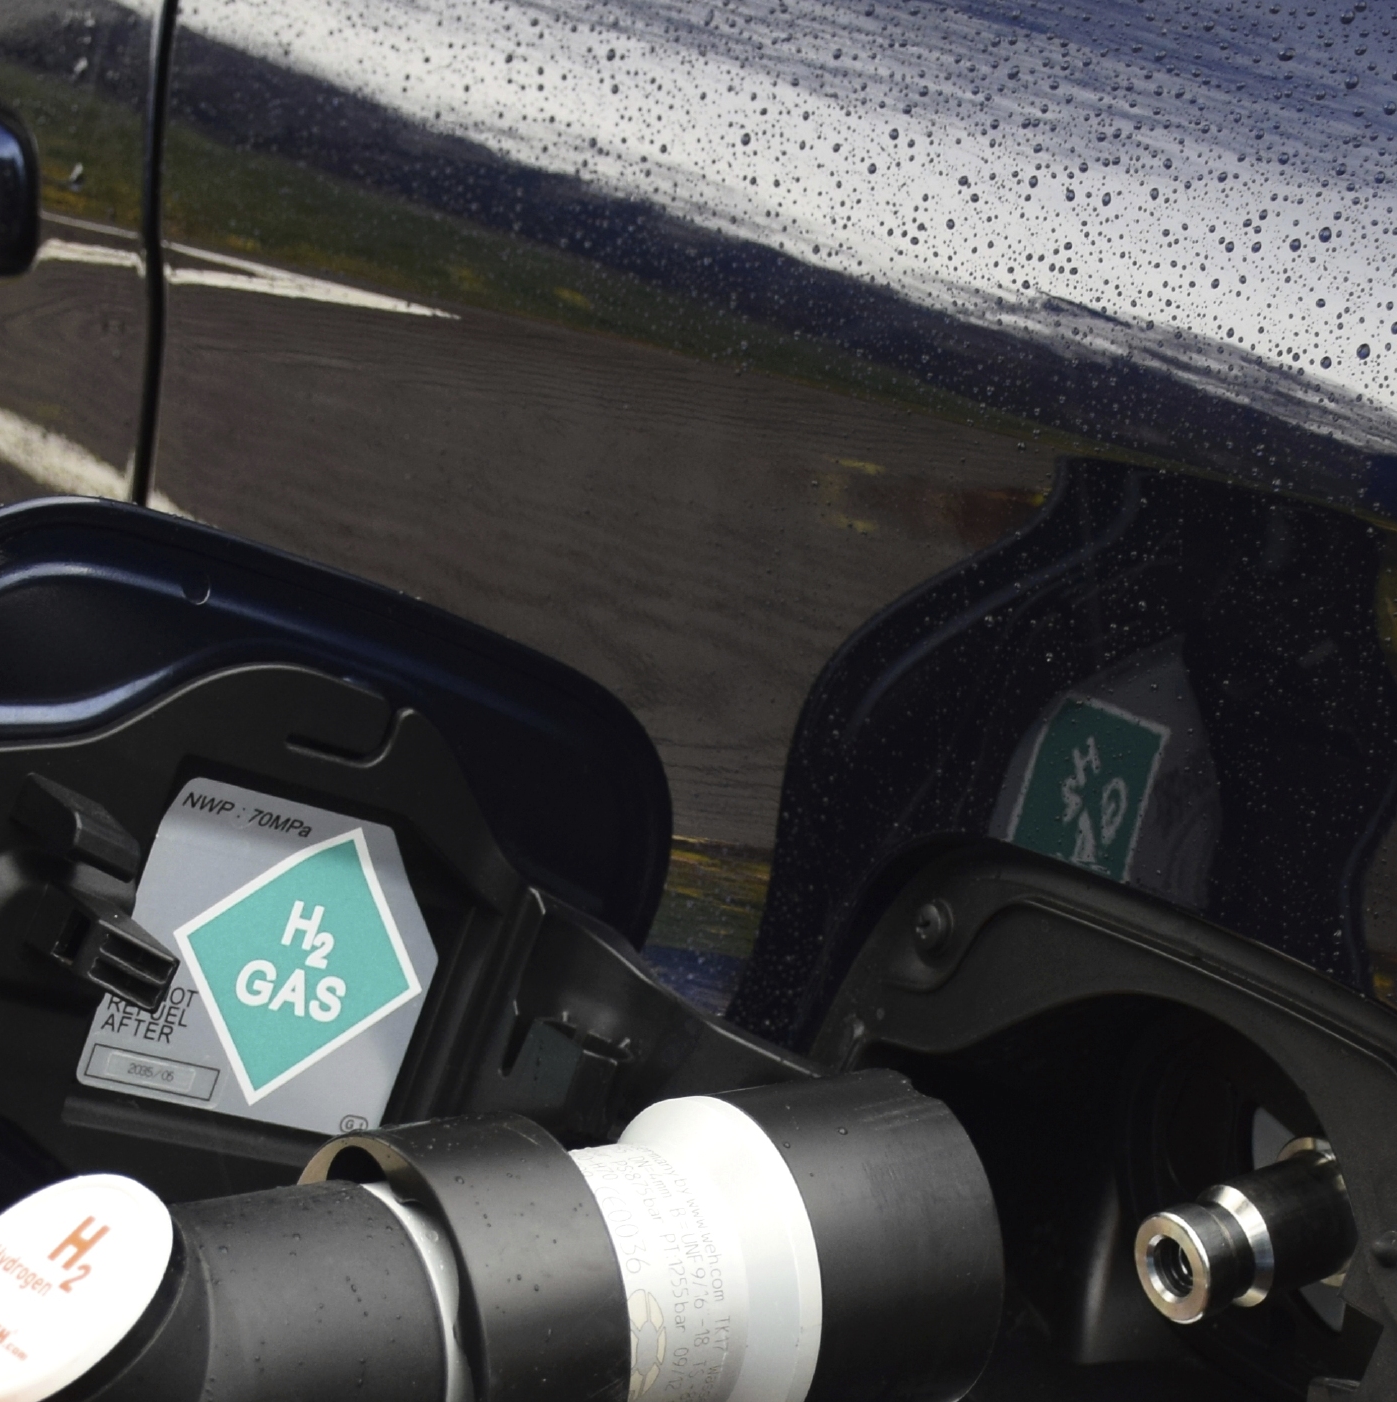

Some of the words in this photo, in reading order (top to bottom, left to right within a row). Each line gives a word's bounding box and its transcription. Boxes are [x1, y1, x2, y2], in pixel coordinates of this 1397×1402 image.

[182, 792, 235, 816] NWP
[248, 808, 313, 838] 70MPa
[280, 899, 335, 970] H2
[164, 986, 199, 1008] OT
[235, 959, 346, 1023] GAS
[100, 1013, 174, 1044] AFTER
[47, 1215, 111, 1293] H2
[686, 1198, 725, 1302] www.weh.com
